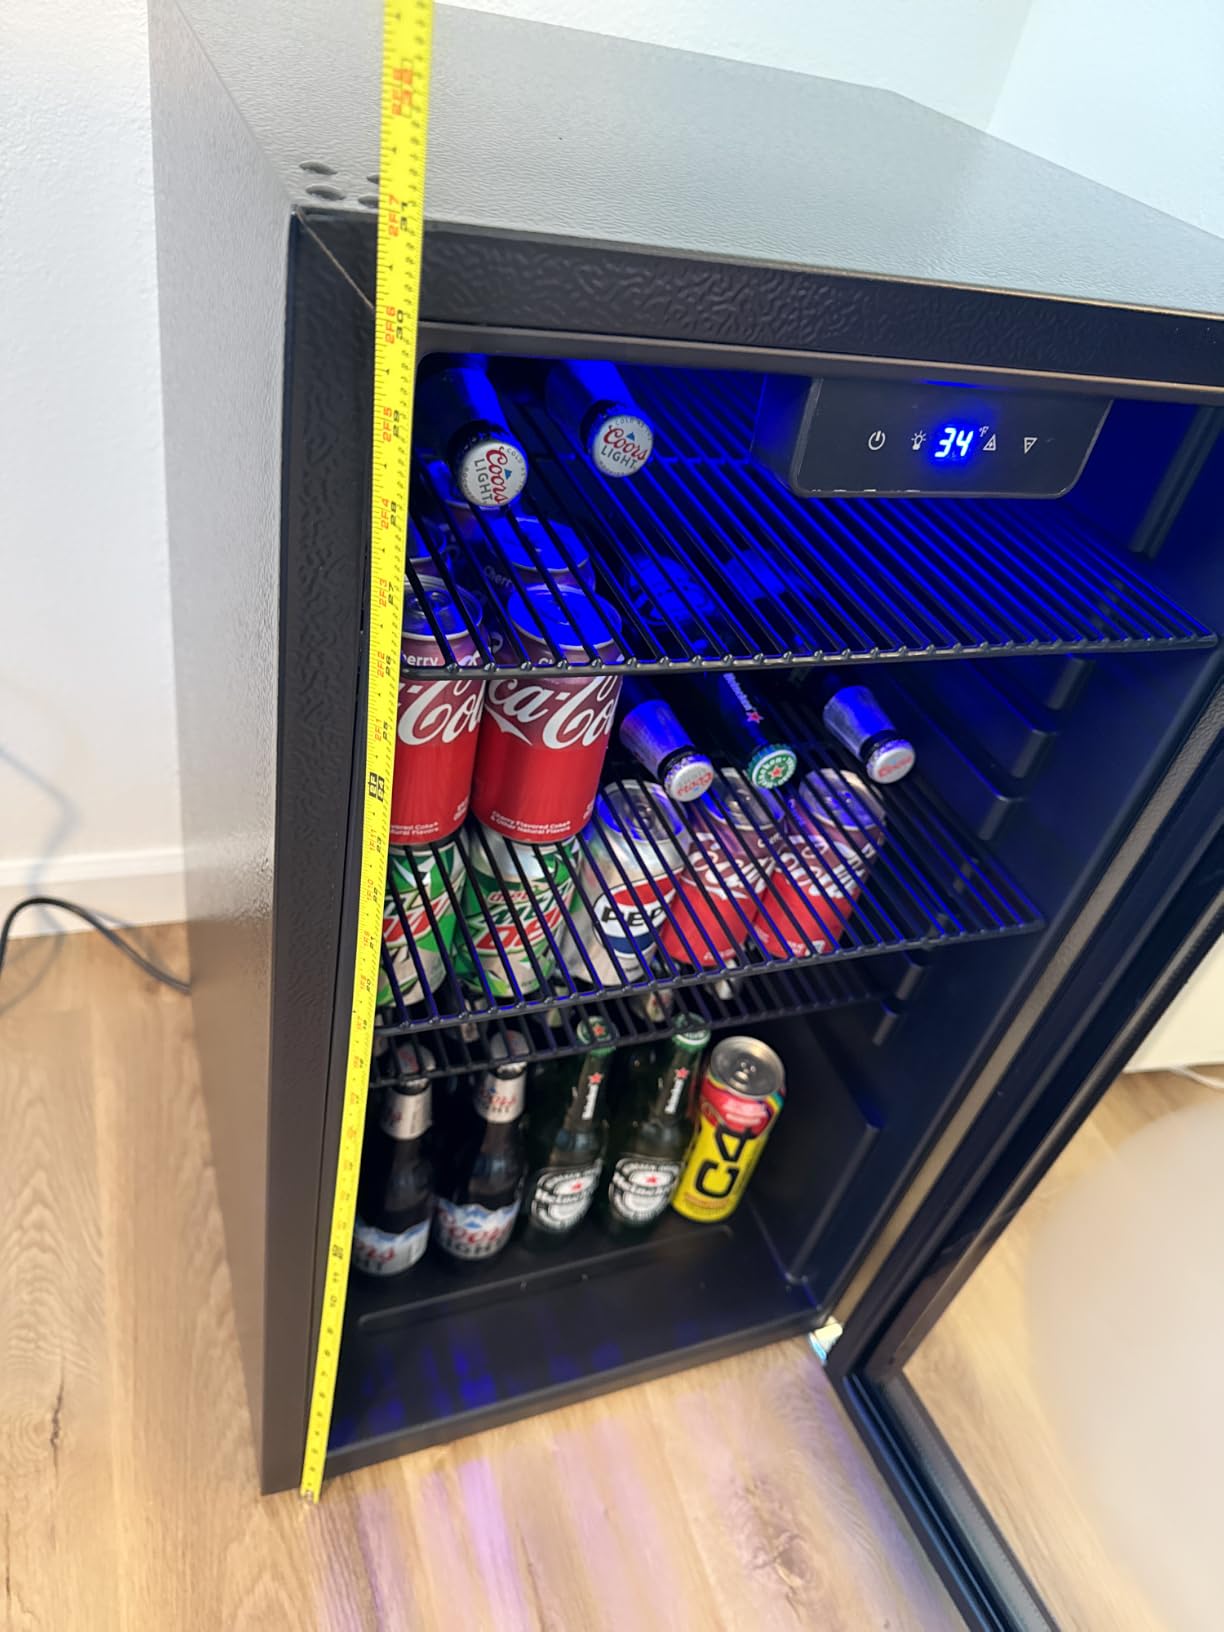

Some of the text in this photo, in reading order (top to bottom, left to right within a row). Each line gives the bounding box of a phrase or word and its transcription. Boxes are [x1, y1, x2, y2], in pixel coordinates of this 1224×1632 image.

[396, 309, 405, 340] 30
[601, 446, 638, 469] LIGHT
[603, 425, 648, 462] Coors
[934, 427, 973, 458] 34
[474, 458, 493, 503] LIGHT
[486, 447, 509, 504] Coors
